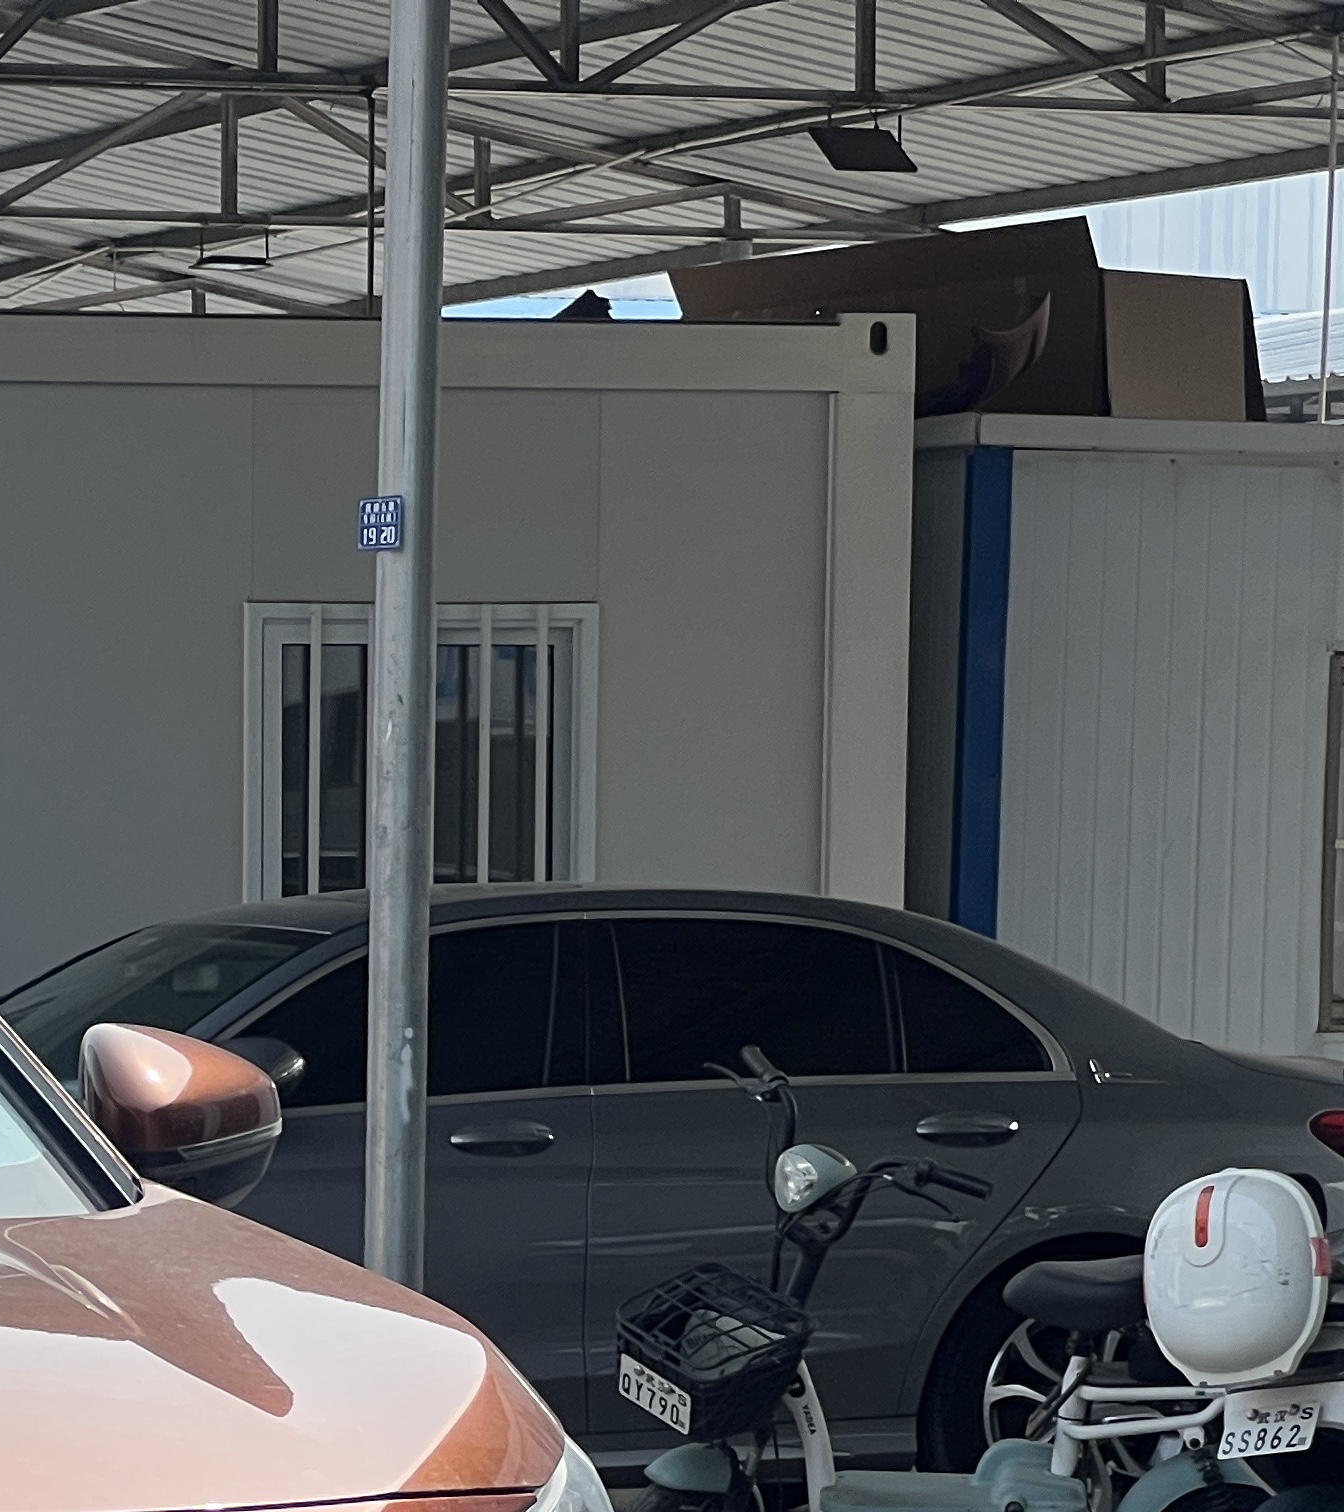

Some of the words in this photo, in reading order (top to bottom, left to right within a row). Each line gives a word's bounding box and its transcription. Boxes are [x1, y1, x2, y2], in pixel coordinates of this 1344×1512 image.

[363, 527, 377, 545] 19
[380, 526, 396, 544] 20
[622, 1373, 680, 1425] QY790
[1222, 1424, 1301, 1455] SS862
